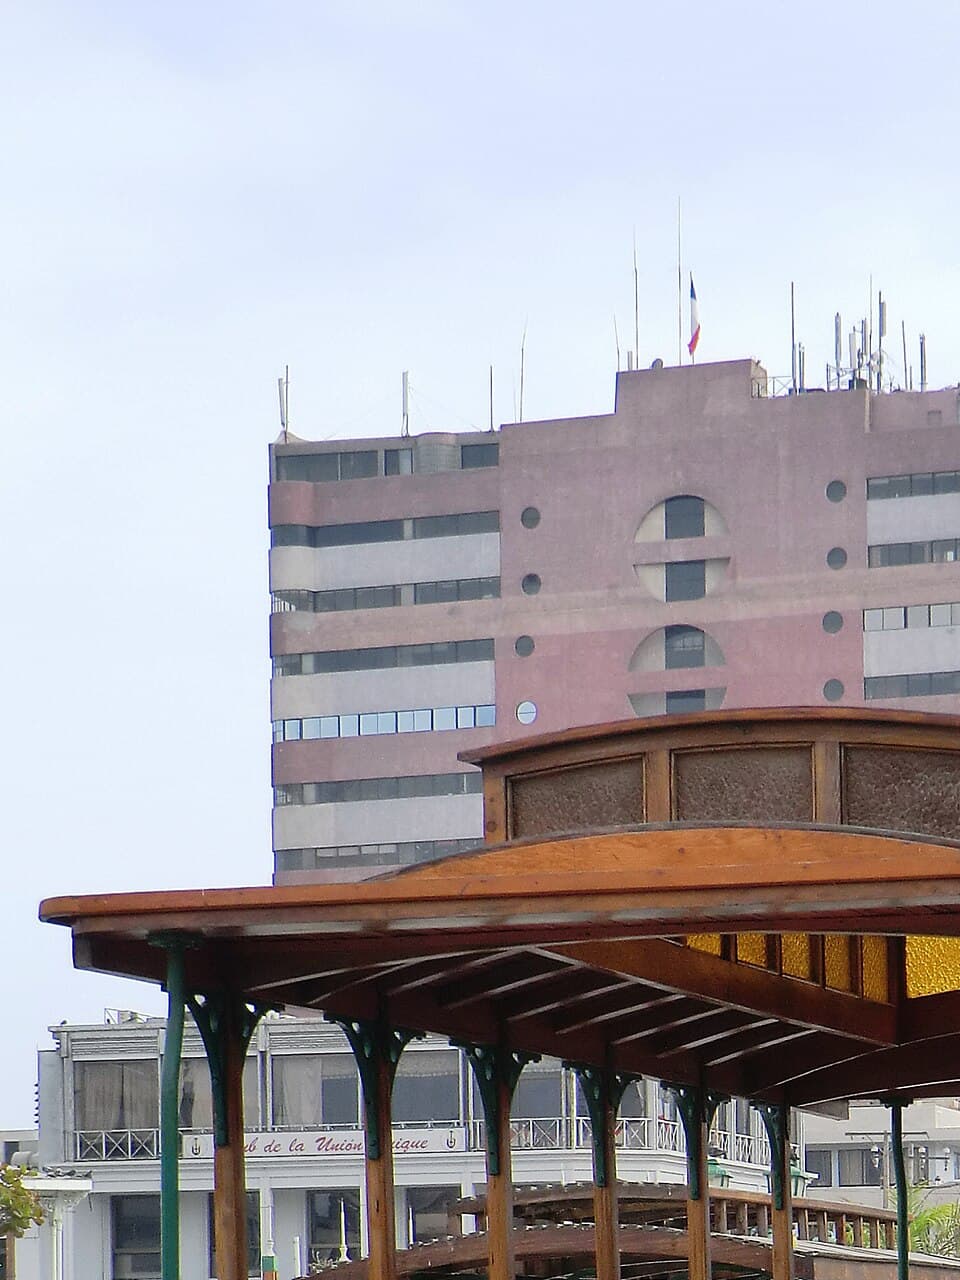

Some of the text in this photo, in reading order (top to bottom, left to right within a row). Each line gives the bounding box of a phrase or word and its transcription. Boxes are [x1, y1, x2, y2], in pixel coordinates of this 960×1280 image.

[264, 1138, 281, 1153] de
[289, 1136, 305, 1152] la
[315, 1136, 364, 1152] Unión
